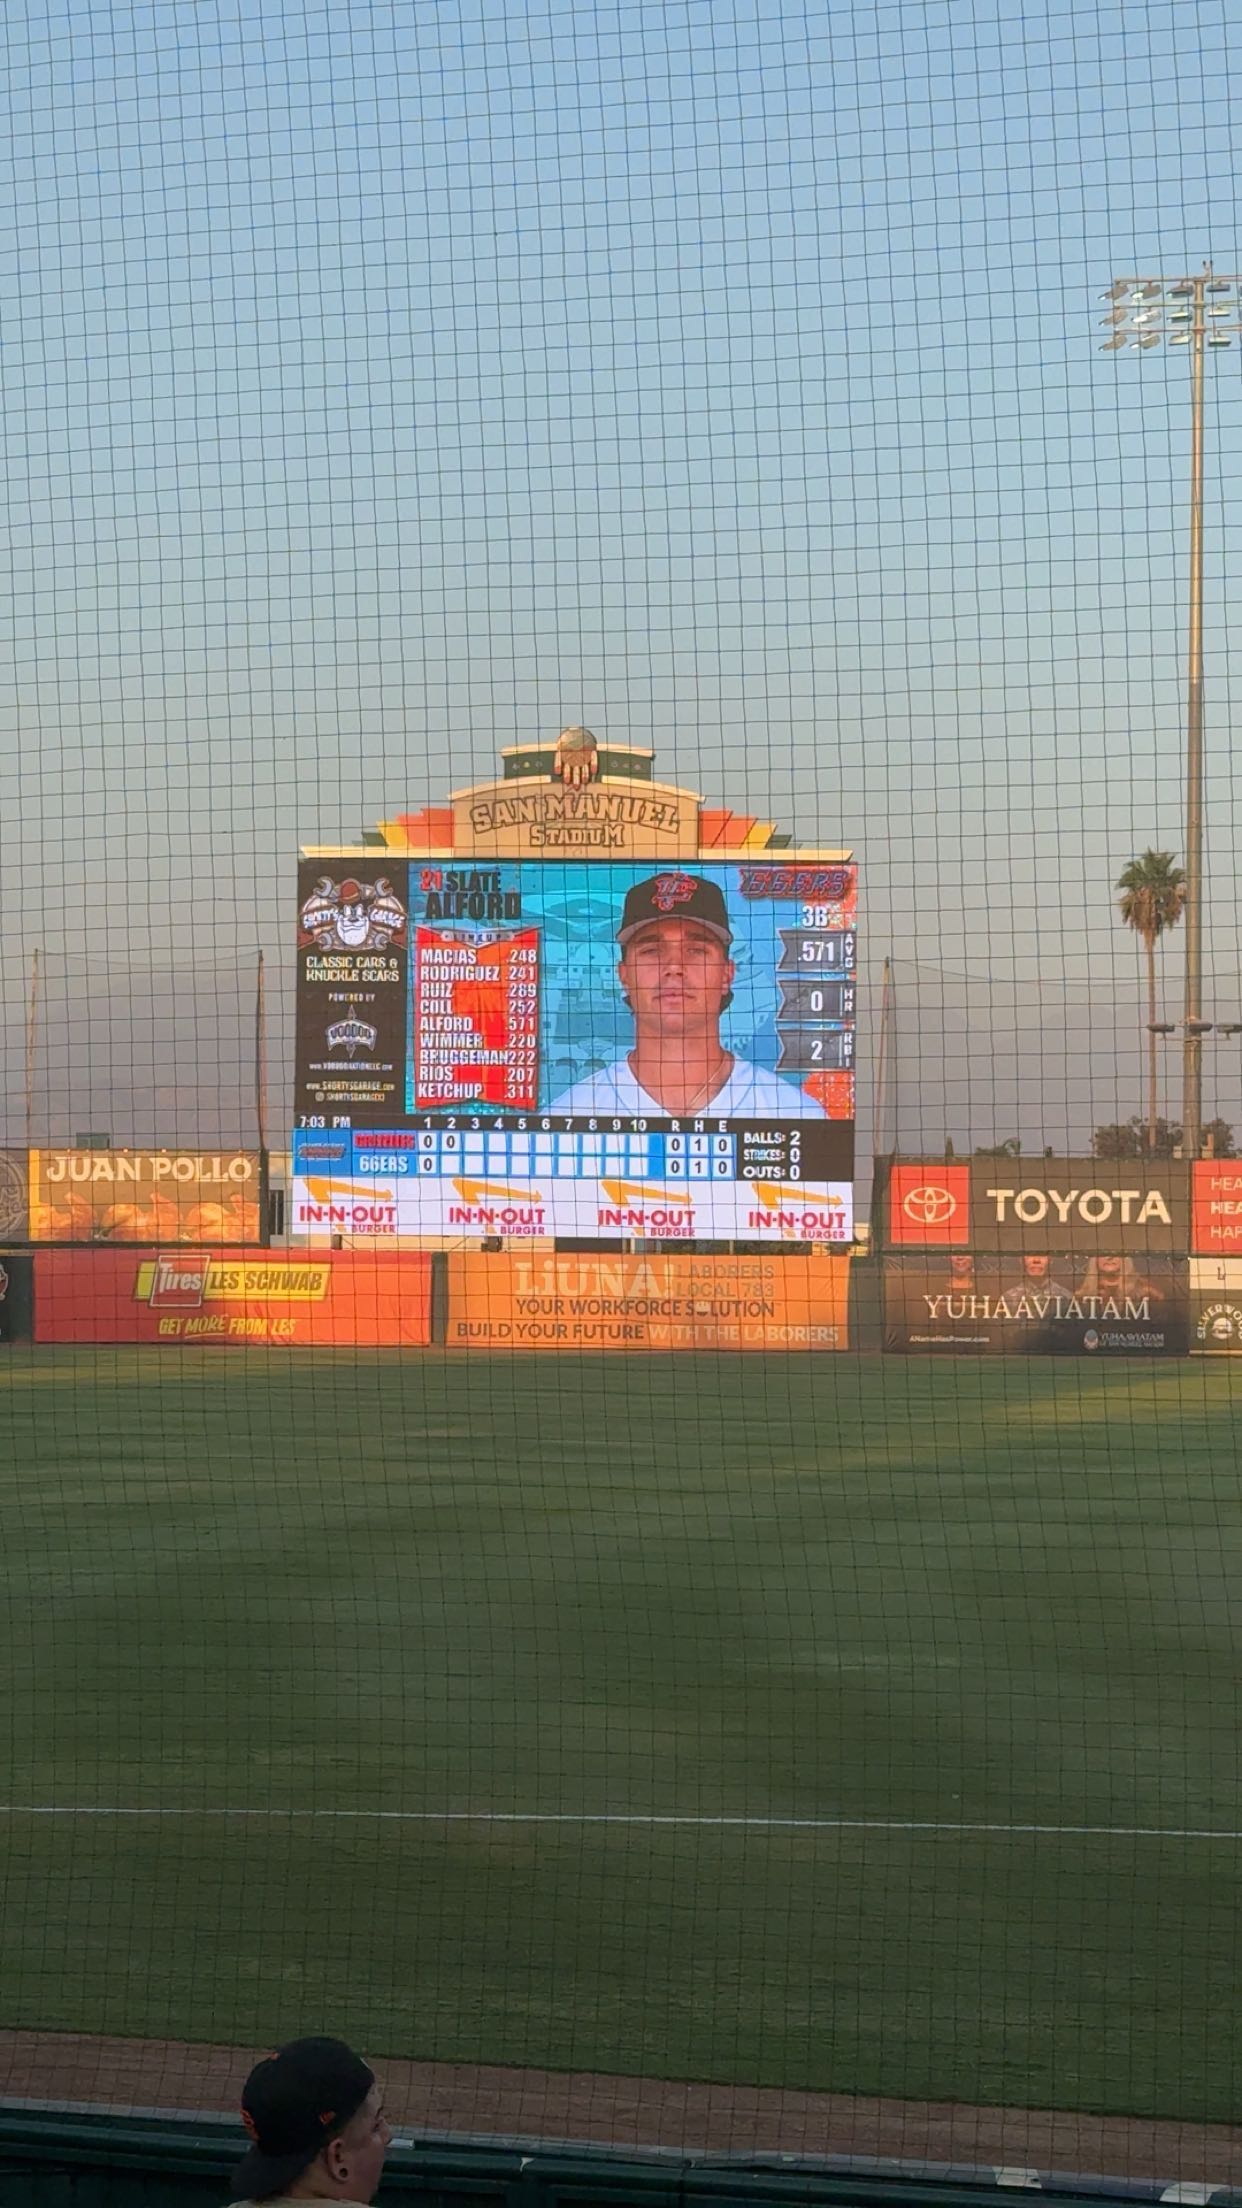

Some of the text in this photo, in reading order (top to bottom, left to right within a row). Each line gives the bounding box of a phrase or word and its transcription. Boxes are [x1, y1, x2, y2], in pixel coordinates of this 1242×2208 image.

[470, 793, 680, 834] SAN MANUEL
[530, 823, 625, 848] STADIUM
[420, 869, 501, 891] 21 SLATE
[426, 892, 521, 919] ALFORD
[802, 906, 828, 927] 3B
[420, 949, 537, 964] MACIAS .248
[797, 933, 854, 968] .571 AVG
[306, 956, 353, 968] CLASSIC
[356, 957, 386, 968] CARS
[306, 970, 399, 981] KNUCKLE SCARS
[420, 965, 535, 981] RODRIGUEZ .241
[329, 993, 375, 1002] POWERED BY
[420, 982, 537, 998] RUIZ .289
[420, 999, 453, 1014] COLL
[811, 989, 853, 1012] 0 HR
[420, 1016, 534, 1031] ALFORD .571
[420, 1033, 536, 1048] WIMMER .220
[420, 1050, 508, 1065] BRUGGEMAN
[811, 1032, 853, 1067] 2 RBI
[420, 1066, 534, 1081] RIOS .207
[418, 1083, 533, 1099] KETCHUP .311
[300, 1116, 350, 1129] 7:03 PM
[424, 1117, 727, 1132] 1 2 3 4 5 6 7 8 9 10 R H E
[424, 1135, 432, 1148] 0
[446, 1135, 455, 1148] 0
[672, 1138, 680, 1151] 0
[696, 1138, 702, 1151] 1
[719, 1139, 727, 1152] 0
[744, 1131, 800, 1145] BALLS: 2
[790, 1148, 800, 1163] 0
[46, 1157, 252, 1182] JUAN POLLO
[360, 1155, 727, 1174] 66ERS 0 0 1 0
[743, 1165, 800, 1180] OUTS: 0
[300, 1206, 396, 1222] IN-N-OUT
[987, 1188, 1171, 1224] TOYOTA
[450, 1207, 545, 1225] IN-N-OUT
[598, 1209, 696, 1226] IN-N-OUT
[749, 1212, 846, 1228] IN-N-OUT
[352, 1225, 396, 1233] BURGER
[500, 1227, 545, 1235] BURGER
[651, 1228, 695, 1237] BURGER
[801, 1230, 845, 1239] BURGER
[159, 1262, 322, 1293] Tires LES SCHWAB
[677, 1265, 774, 1279] LABORERS
[676, 1282, 774, 1297] LOCAL 783
[515, 1299, 565, 1315] YOUR
[569, 1299, 681, 1316] WORKFORCE
[923, 1295, 1150, 1321] YUHAAVIATAM
[159, 1314, 296, 1335] GET MORE FROM LES
[457, 1322, 511, 1337] BUILD
[515, 1323, 568, 1338] YOUR
[573, 1324, 644, 1339] FUTURE
[704, 1326, 740, 1341] THE
[744, 1327, 839, 1342] LABORERS
